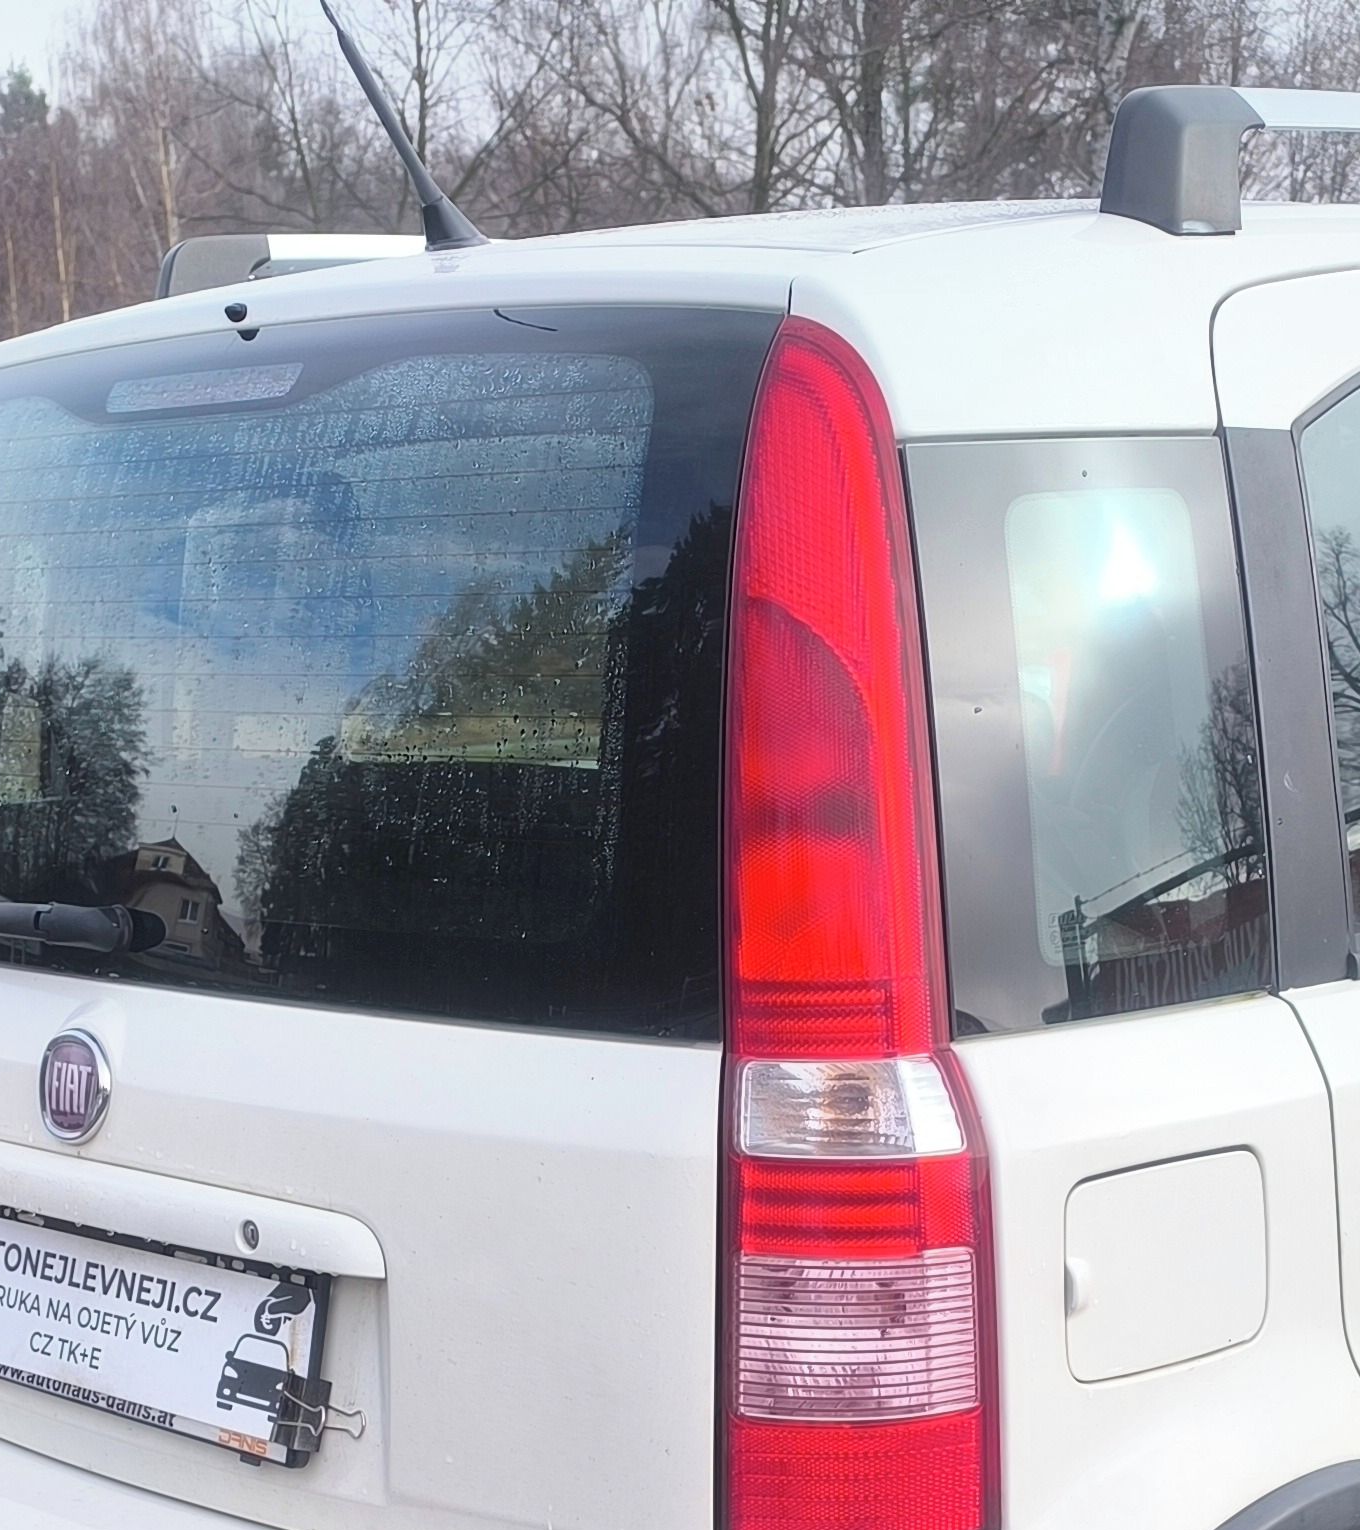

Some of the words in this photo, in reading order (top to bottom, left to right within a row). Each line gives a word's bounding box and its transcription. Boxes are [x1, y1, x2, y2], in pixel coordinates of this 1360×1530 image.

[51, 1061, 93, 1115] FIAT
[30, 1331, 54, 1356] CZ
[58, 1337, 102, 1370] TK+E
[46, 1298, 72, 1325] NA
[77, 1306, 137, 1340] OJETÝ
[141, 1317, 182, 1353] VŮZ
